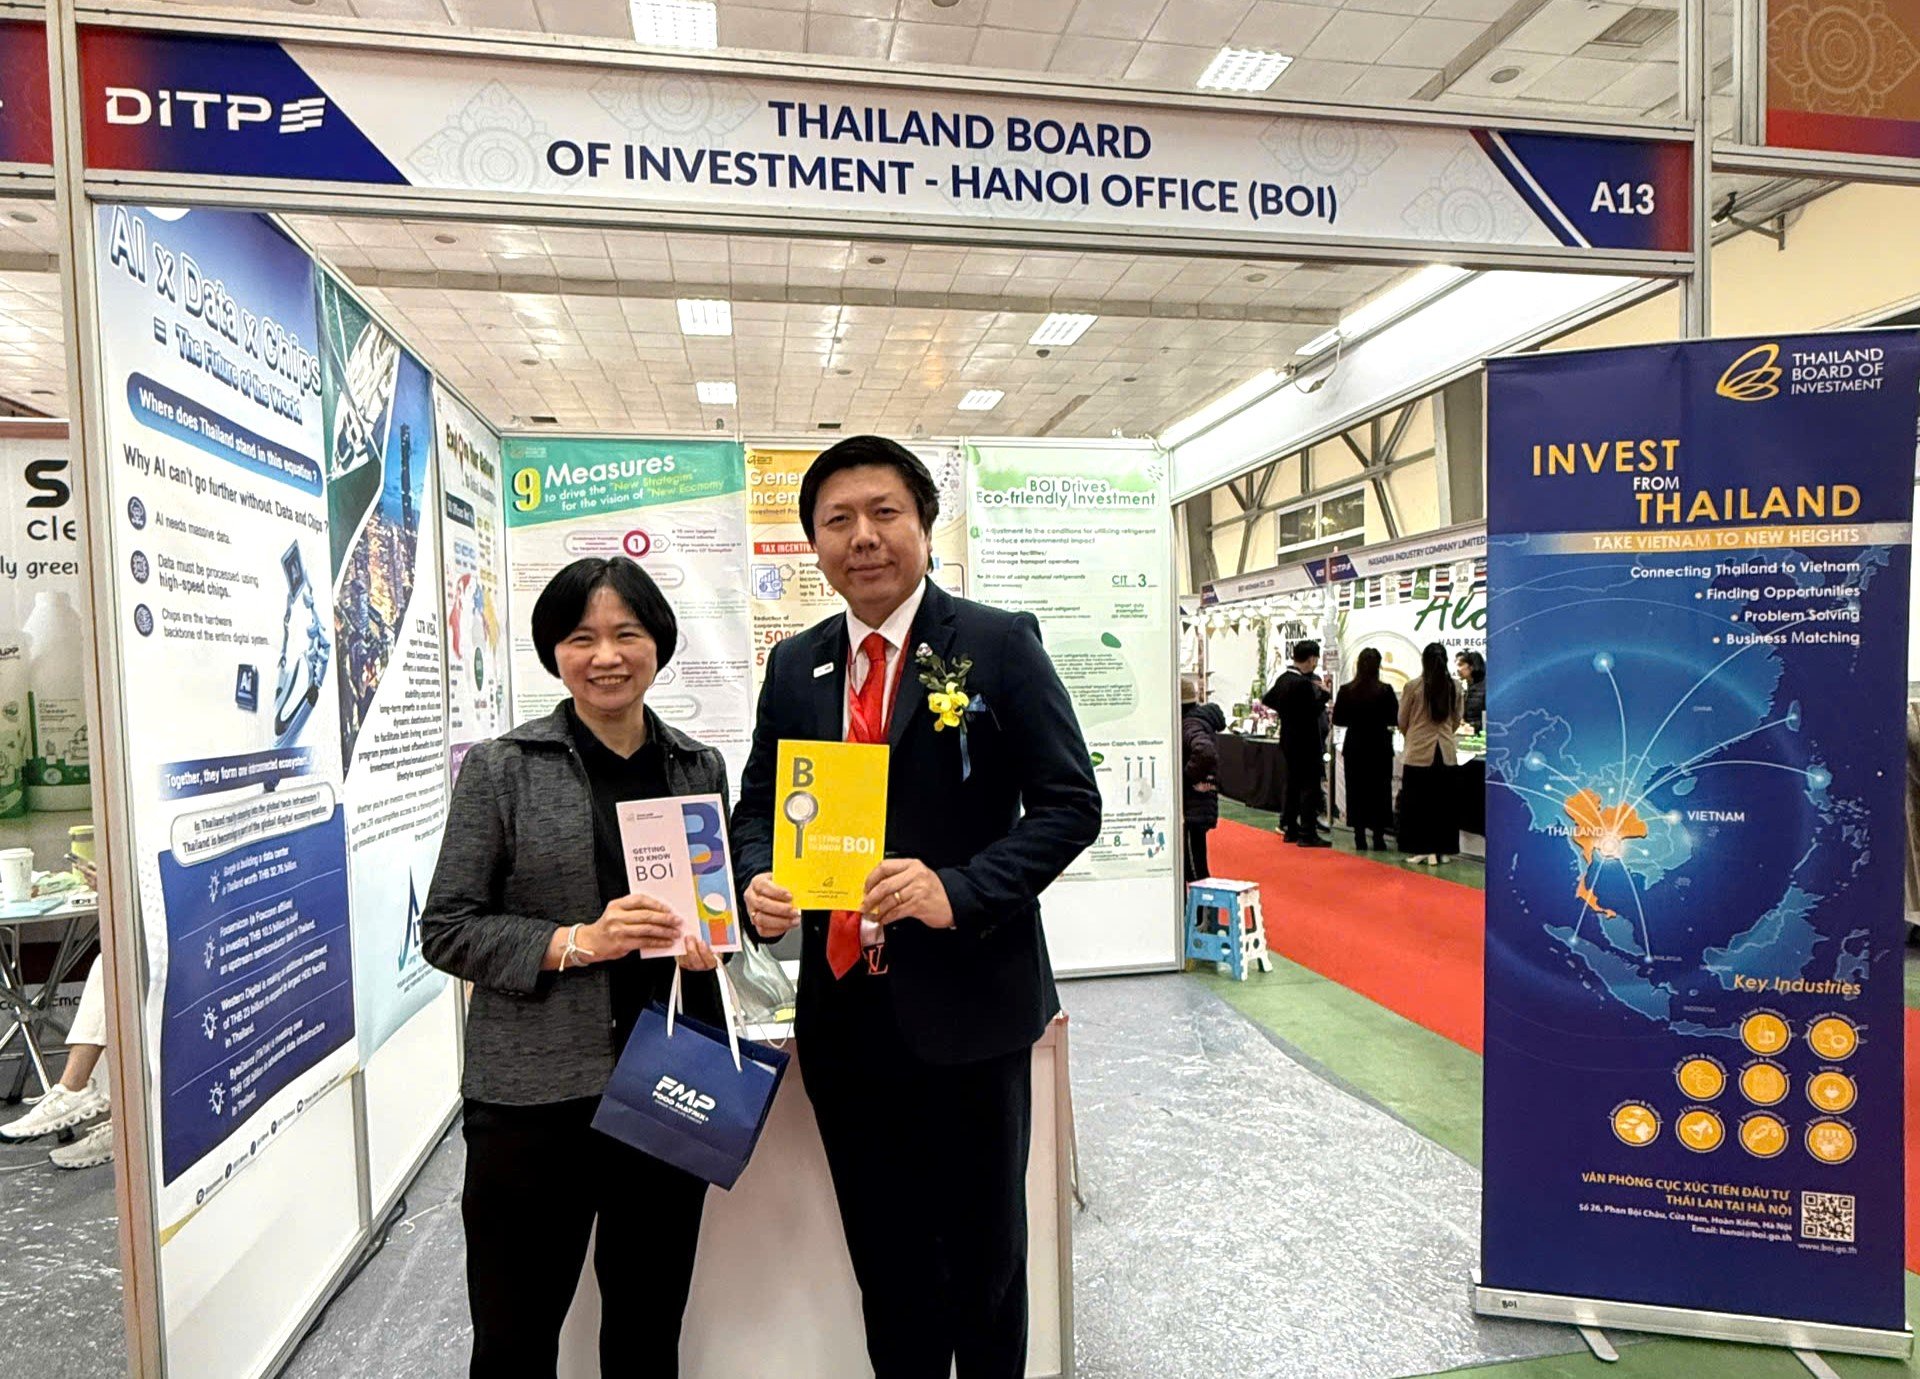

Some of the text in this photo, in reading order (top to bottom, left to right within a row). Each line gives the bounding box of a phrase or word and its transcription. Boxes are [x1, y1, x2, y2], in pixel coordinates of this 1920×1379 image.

[105, 87, 272, 131] DITP
[768, 101, 1151, 160] THAILAND BOARD
[546, 139, 1338, 225] OF INVESTMENT - HANOI OFFICE (BOI)
[1590, 181, 1656, 217] A13
[110, 204, 147, 287] AI
[181, 252, 239, 346] Data
[262, 317, 323, 397] Chips
[175, 322, 203, 369] The
[203, 340, 239, 391] Future
[1791, 347, 1884, 366] THAILAND
[1791, 362, 1884, 381] BOARD OF
[1790, 377, 1884, 396] INVESTMENT
[138, 387, 312, 482] Where does Thailand stand in this equation
[1533, 439, 1681, 476] INVEST
[123, 443, 323, 535] Why AI can't go further without Data and Chips
[514, 467, 542, 513] 9
[544, 455, 676, 489] Measures
[1031, 480, 1107, 492] BOI Drives
[1633, 476, 1680, 491] FROM
[545, 492, 556, 503] to
[559, 487, 587, 501] drive
[588, 485, 607, 497] the
[561, 500, 577, 512] for
[581, 497, 597, 509] the
[599, 493, 630, 507] vision
[632, 489, 643, 500] of
[750, 489, 799, 506] Incen
[976, 491, 1156, 507] Eco-friendly Investment
[1635, 484, 1861, 524] THAILAND
[761, 544, 776, 553] TAX
[1394, 535, 1486, 562] INDUSTRY COMPANY LIMITED
[1592, 527, 1860, 551] TAKE VIETNAM TO NEW HEIGHTS
[0, 555, 79, 580] ly gree
[1630, 560, 1860, 581] Connecting Thailand to Vietnam
[819, 583, 836, 597] 13
[1111, 573, 1147, 588] CIT 3
[1706, 584, 1861, 603] Finding Opportunities
[1744, 607, 1860, 624] Problem Solving
[1726, 629, 1861, 646] Business Matching
[166, 766, 237, 790] Together, they form
[1687, 809, 1745, 823] VIETNAM
[1547, 825, 1603, 837] THAILAND
[182, 837, 211, 853] Thailand
[842, 836, 876, 855] BOI
[1113, 835, 1121, 847] 8
[633, 846, 666, 856] GETTING
[634, 853, 671, 863] TO KNOW
[636, 862, 674, 881] BOI
[1733, 973, 1862, 995] Key Industries
[655, 1075, 716, 1111] FMP
[1607, 1172, 1653, 1189] PHÒNG
[1655, 1178, 1681, 1192] CỤC
[1684, 1179, 1710, 1193] XÚC
[1665, 1191, 1695, 1207] THÁI
[1698, 1198, 1724, 1210] LAN
[1726, 1199, 1745, 1214] TẠI
[1747, 1200, 1767, 1214] HÀ
[1604, 1205, 1627, 1215] Phan
[1711, 1216, 1735, 1227] Hoàn
[1762, 1220, 1775, 1230] Hà
[1691, 1224, 1793, 1243] Email: hanoi@boi.go.th
[1797, 1243, 1858, 1255] www.boi.go.th
